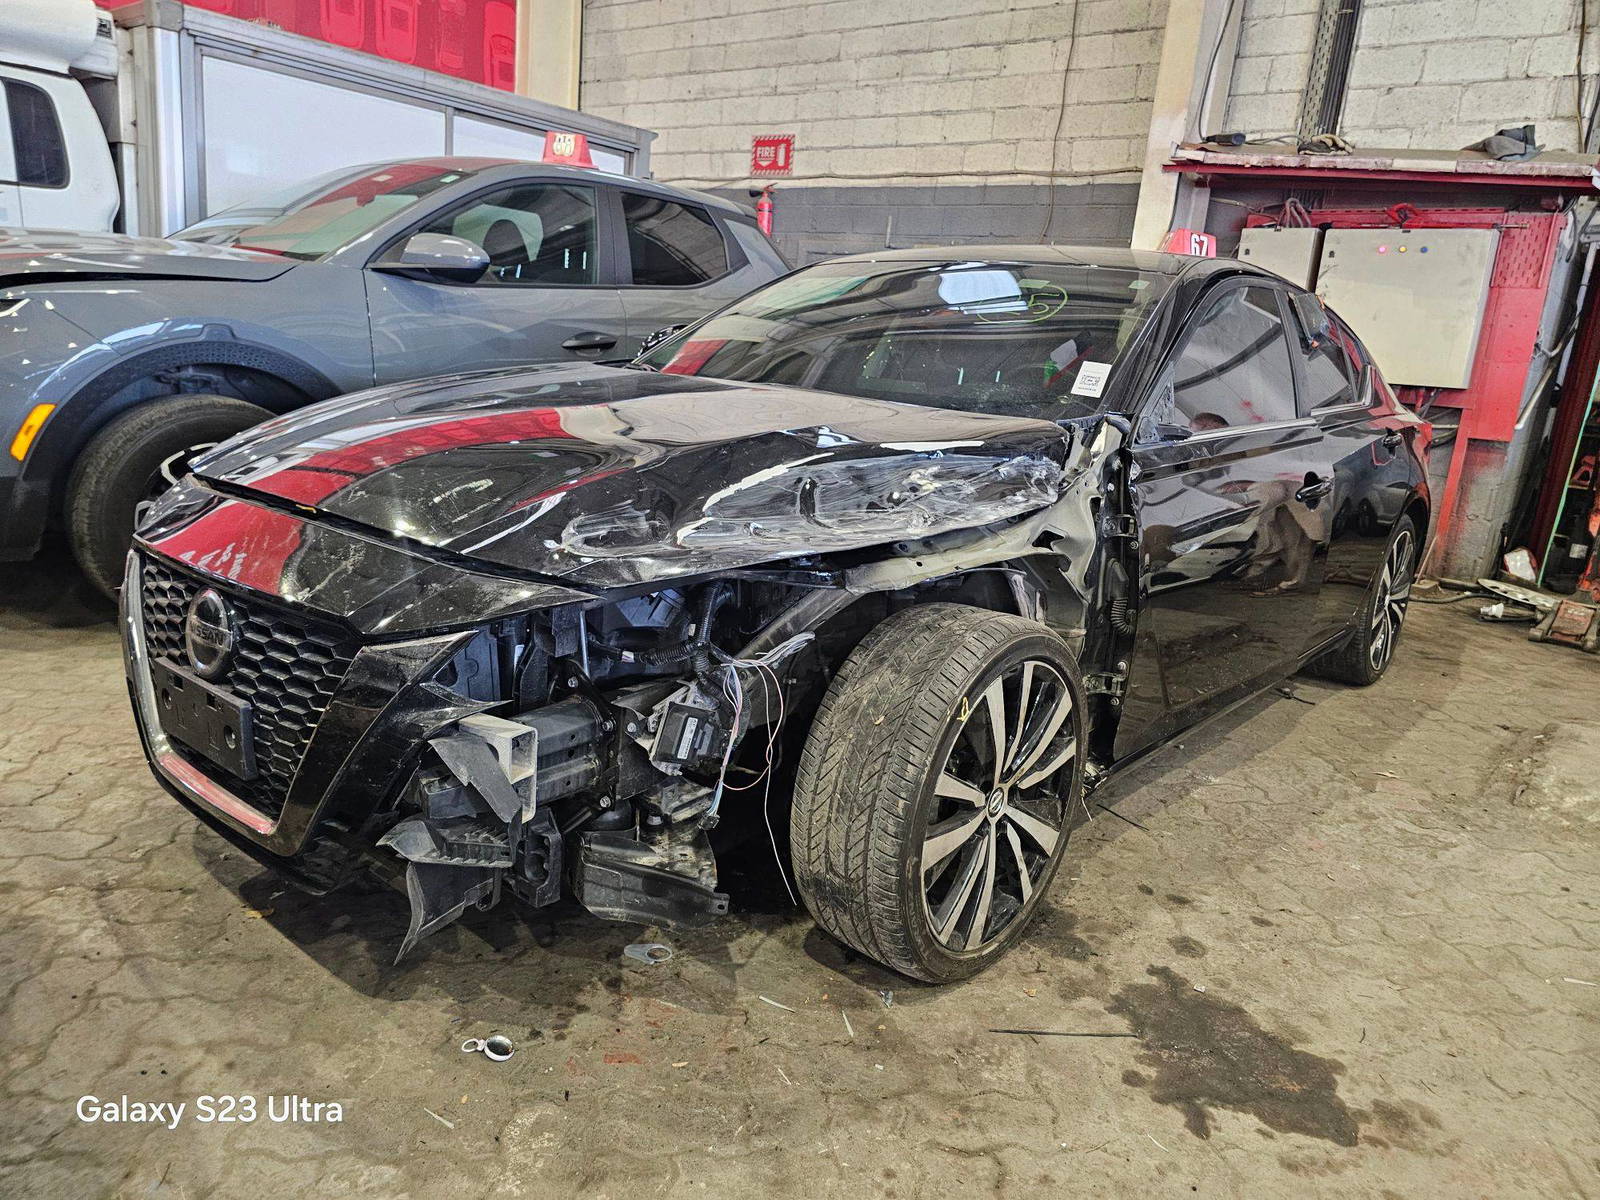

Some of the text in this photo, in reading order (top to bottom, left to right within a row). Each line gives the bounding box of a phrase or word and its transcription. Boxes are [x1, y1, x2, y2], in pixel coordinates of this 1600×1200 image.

[757, 146, 776, 159] FIRE
[1190, 232, 1209, 257] 67
[191, 619, 225, 647] NISSAN
